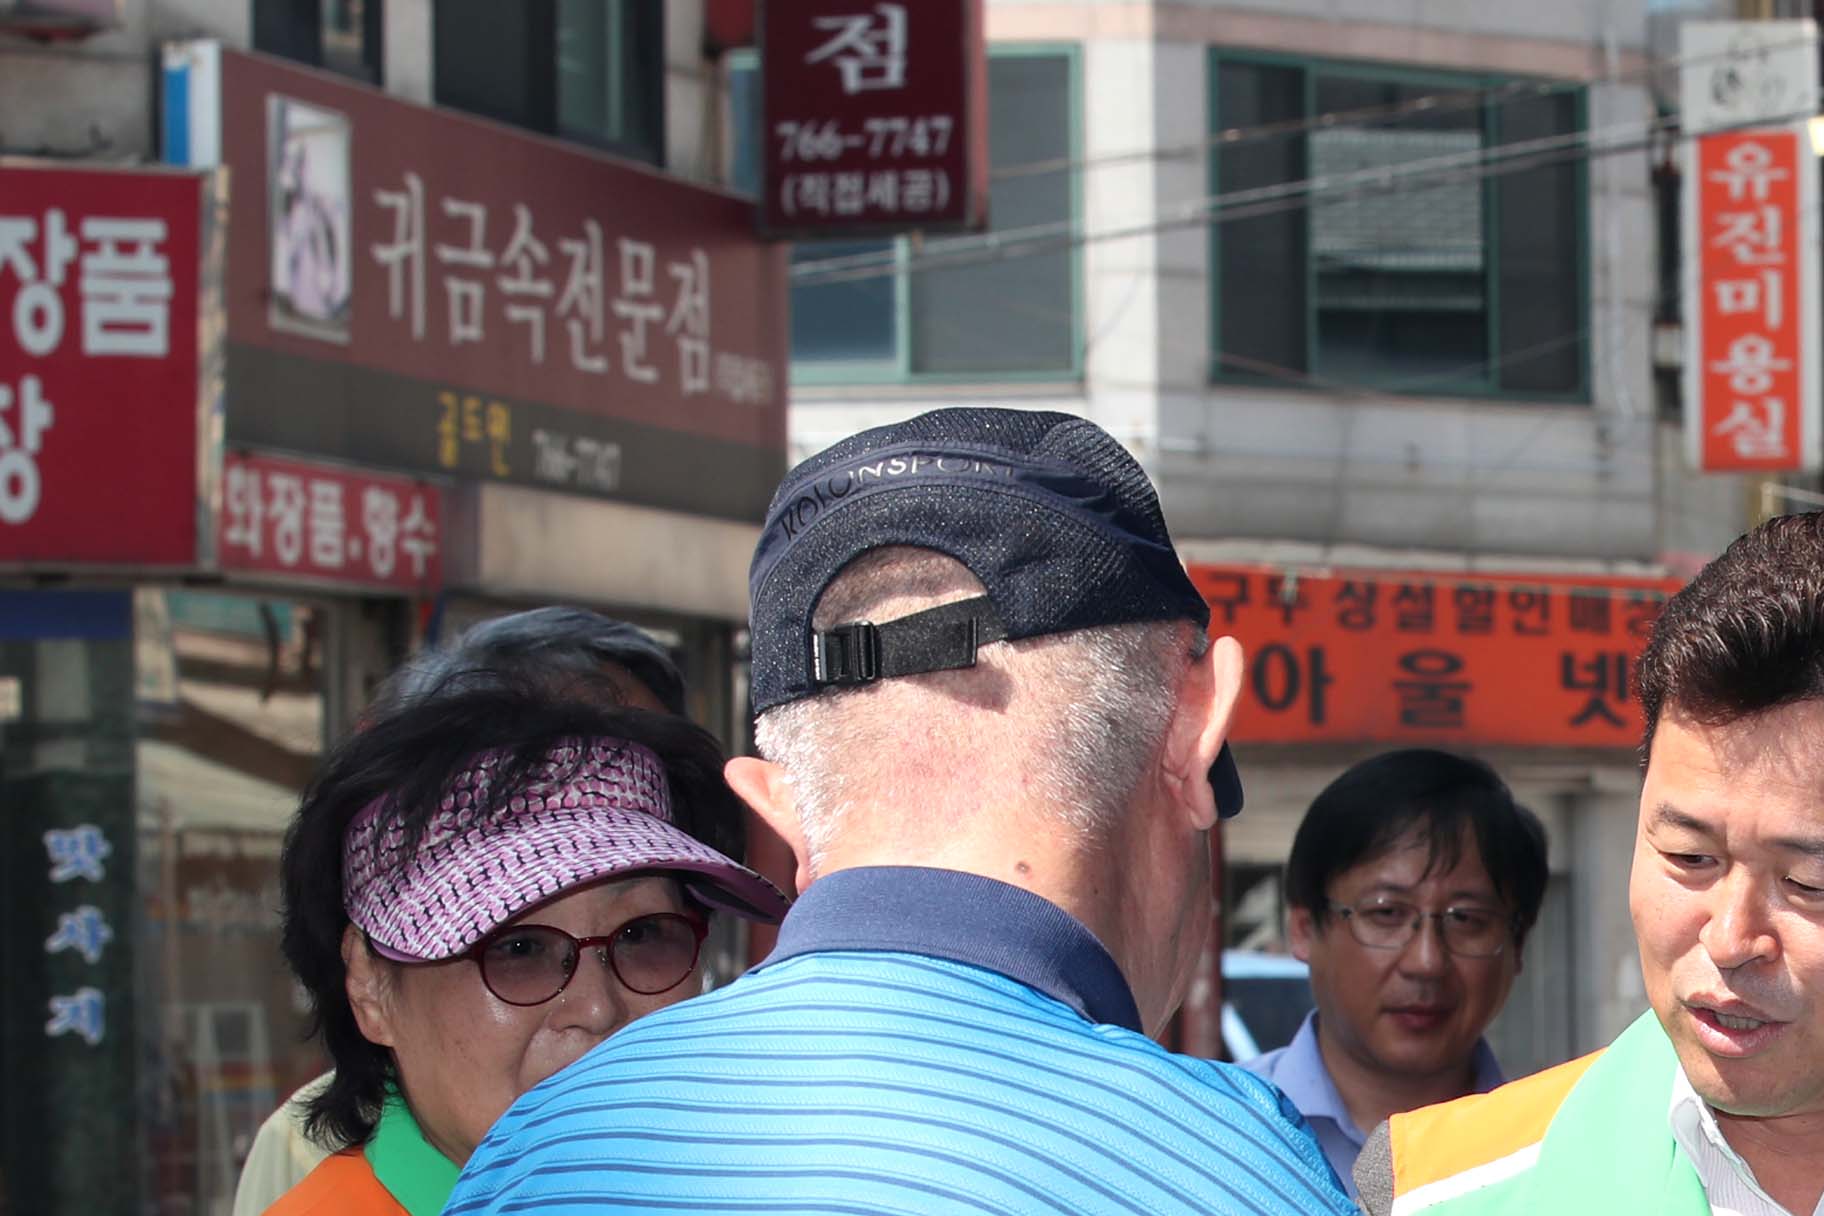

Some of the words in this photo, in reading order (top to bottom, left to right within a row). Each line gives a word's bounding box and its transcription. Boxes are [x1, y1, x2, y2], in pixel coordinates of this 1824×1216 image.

[805, 2, 906, 94] 점
[776, 116, 953, 161] 766-7747
[1708, 142, 1792, 459] 유진미용실
[43, 823, 114, 1046] 맛사지
